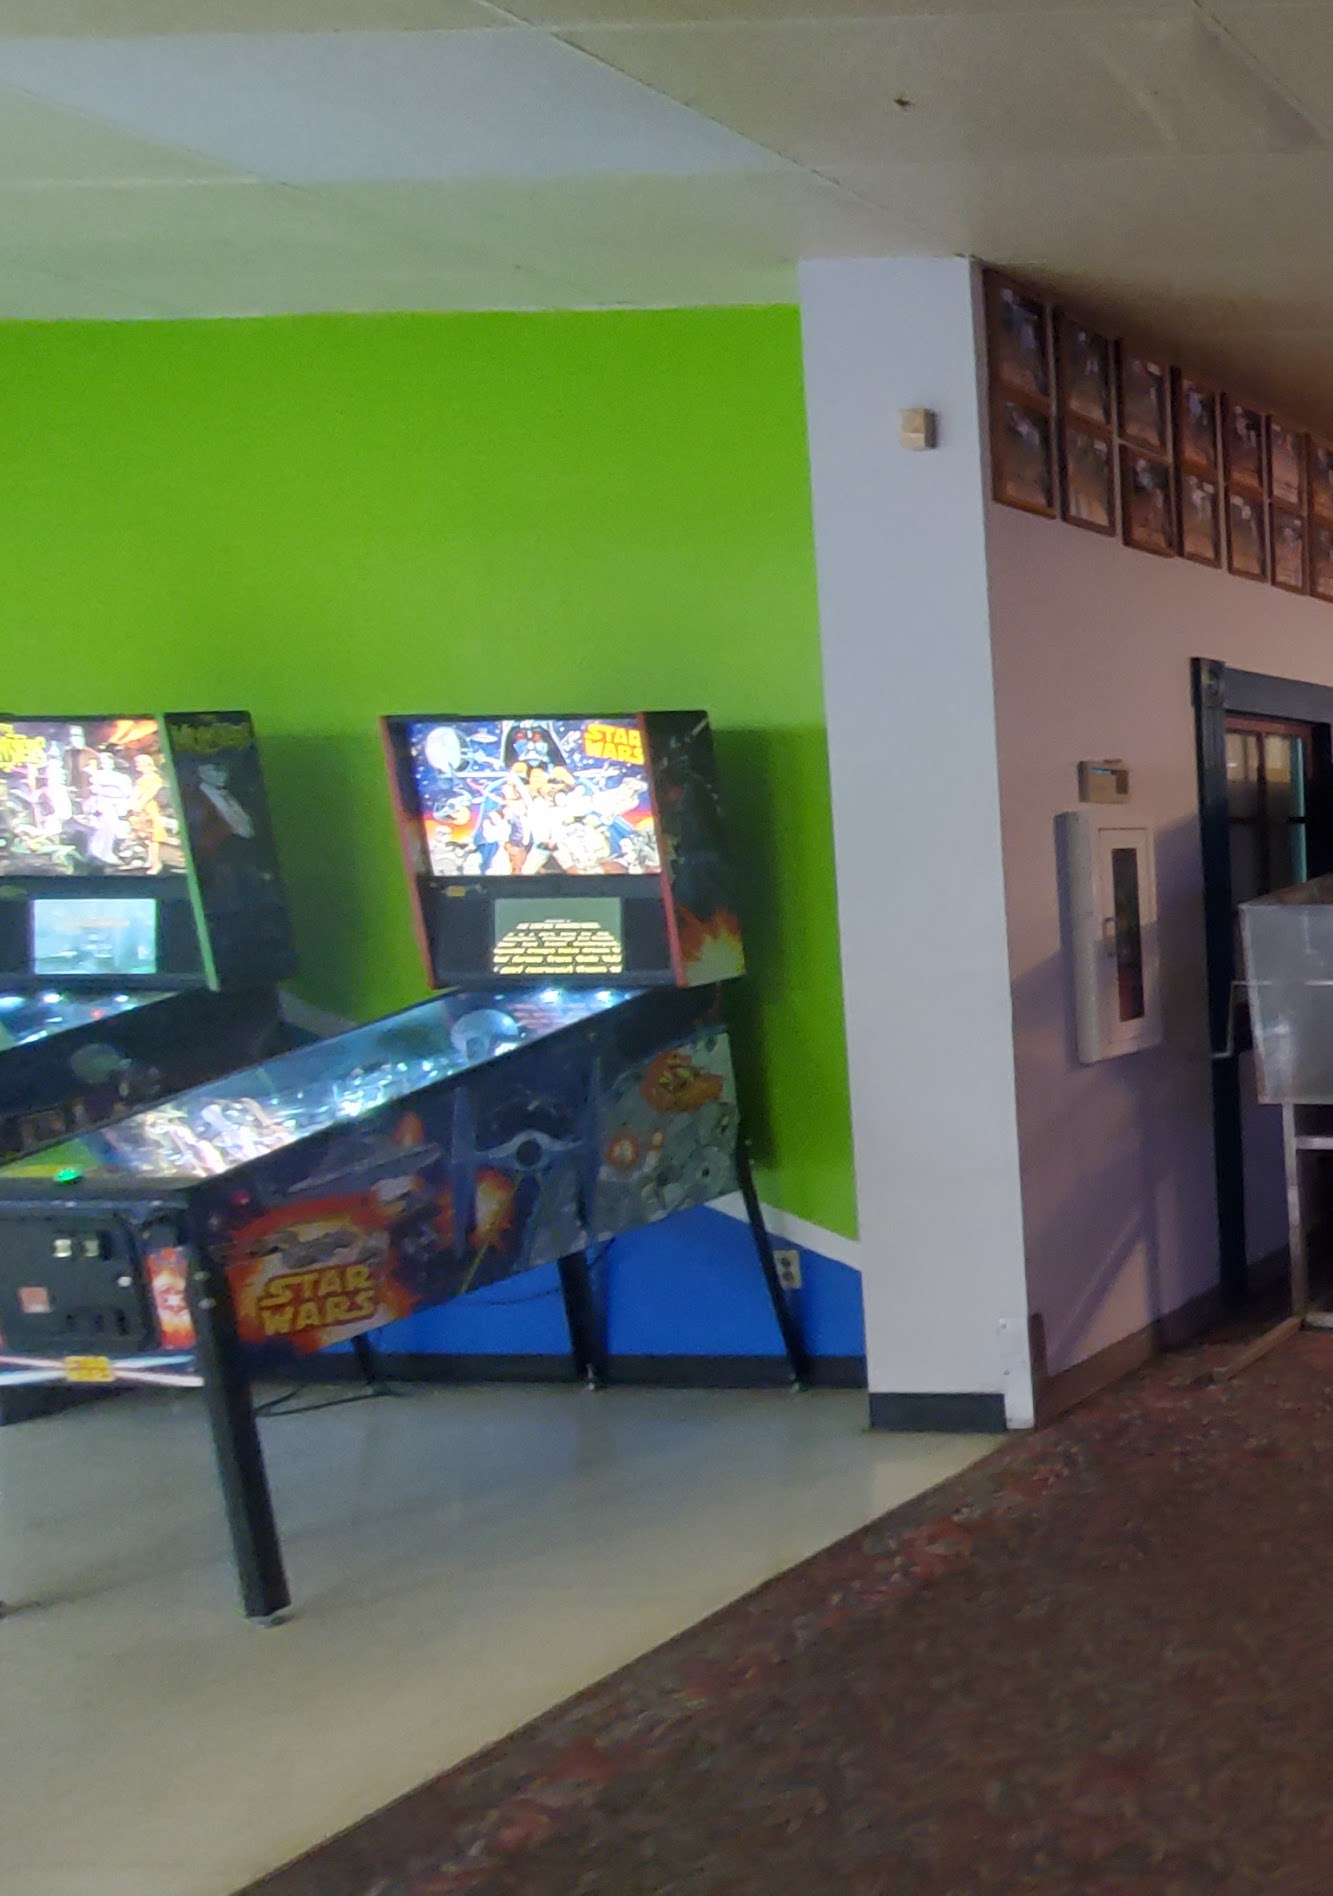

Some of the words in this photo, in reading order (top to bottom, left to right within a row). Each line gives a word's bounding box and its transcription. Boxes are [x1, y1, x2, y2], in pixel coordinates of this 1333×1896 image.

[584, 723, 642, 748] STAR
[584, 739, 645, 765] WARS
[258, 1264, 376, 1307] STAR
[261, 1289, 375, 1336] WARS
